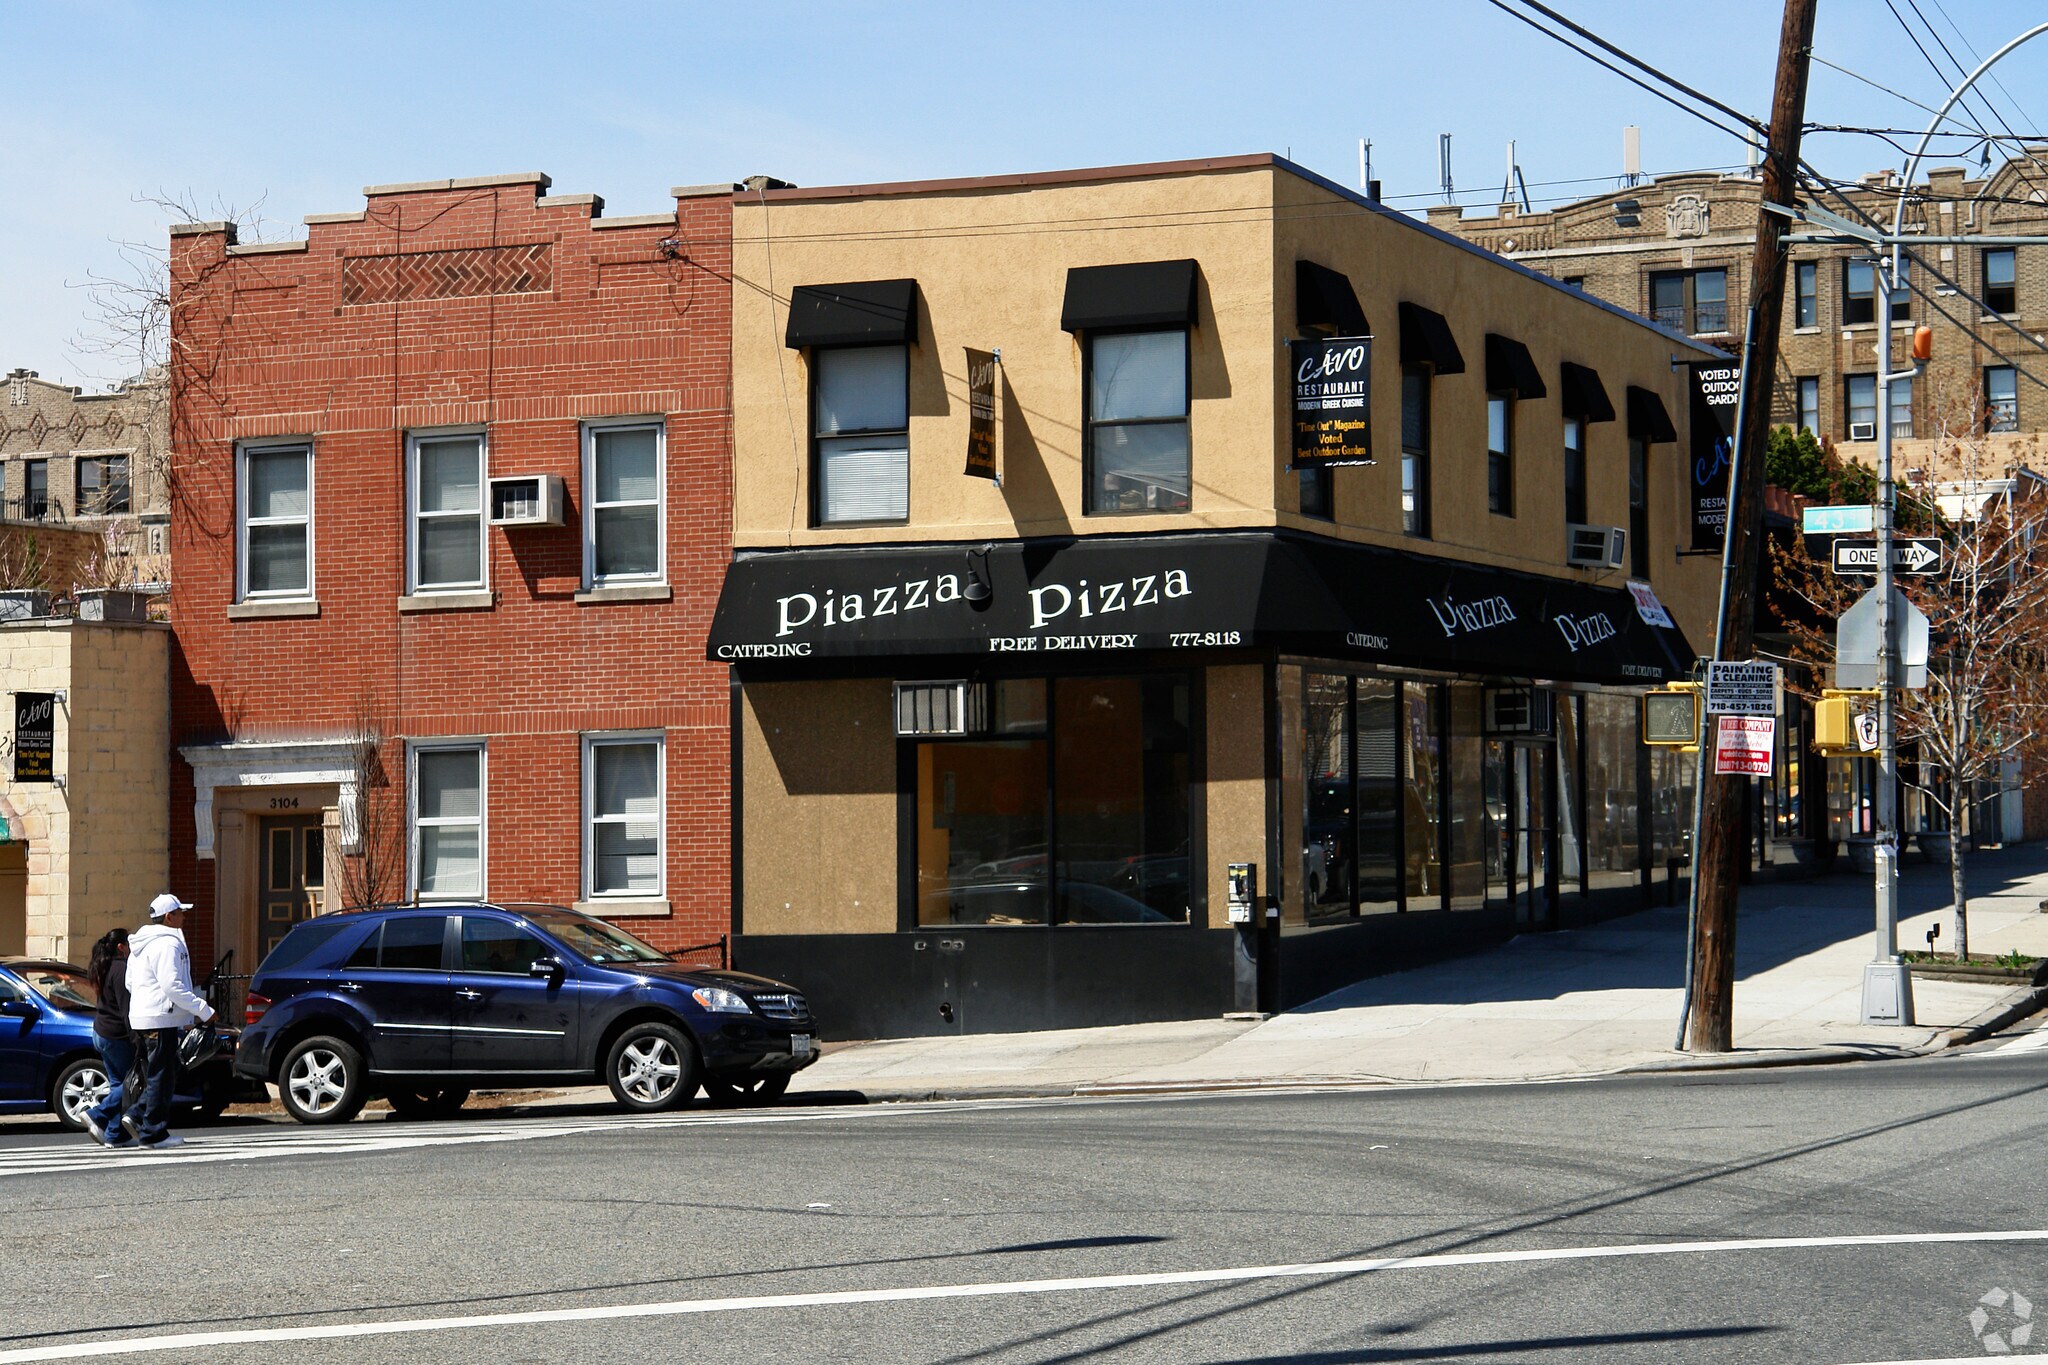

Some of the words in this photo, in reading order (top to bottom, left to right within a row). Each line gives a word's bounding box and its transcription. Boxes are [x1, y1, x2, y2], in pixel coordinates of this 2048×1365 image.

[1699, 369, 1731, 381] VOTED
[1297, 381, 1365, 396] RESTAURANT
[1702, 381, 1740, 394] OUTDO
[1297, 401, 1321, 410] MODERN
[1321, 399, 1341, 409] GREEK
[1341, 398, 1364, 408] CUISINE
[1334, 419, 1366, 432] Magazine
[1318, 433, 1343, 444] Voted
[1297, 448, 1312, 457] Best
[1312, 446, 1341, 457] Outdoor
[1341, 445, 1366, 456] Garden
[1701, 498, 1727, 508] RESTA
[1698, 514, 1726, 525] MODER
[1814, 510, 1844, 529] 43
[1849, 550, 1878, 563] ONE
[1898, 550, 1928, 563] WAY
[989, 637, 1038, 652] FREE
[1044, 634, 1138, 651] DELIVERY
[1169, 631, 1241, 648] 777-8118
[1346, 631, 1389, 650] CATERING
[717, 641, 812, 658] CATERING
[1713, 665, 1773, 674] PAINTING
[1712, 674, 1719, 682] &
[1723, 674, 1773, 682] CLEANING
[1711, 703, 1773, 711] 718-457-1826
[1739, 720, 1771, 732] COMPANY
[270, 797, 299, 809] 3104
